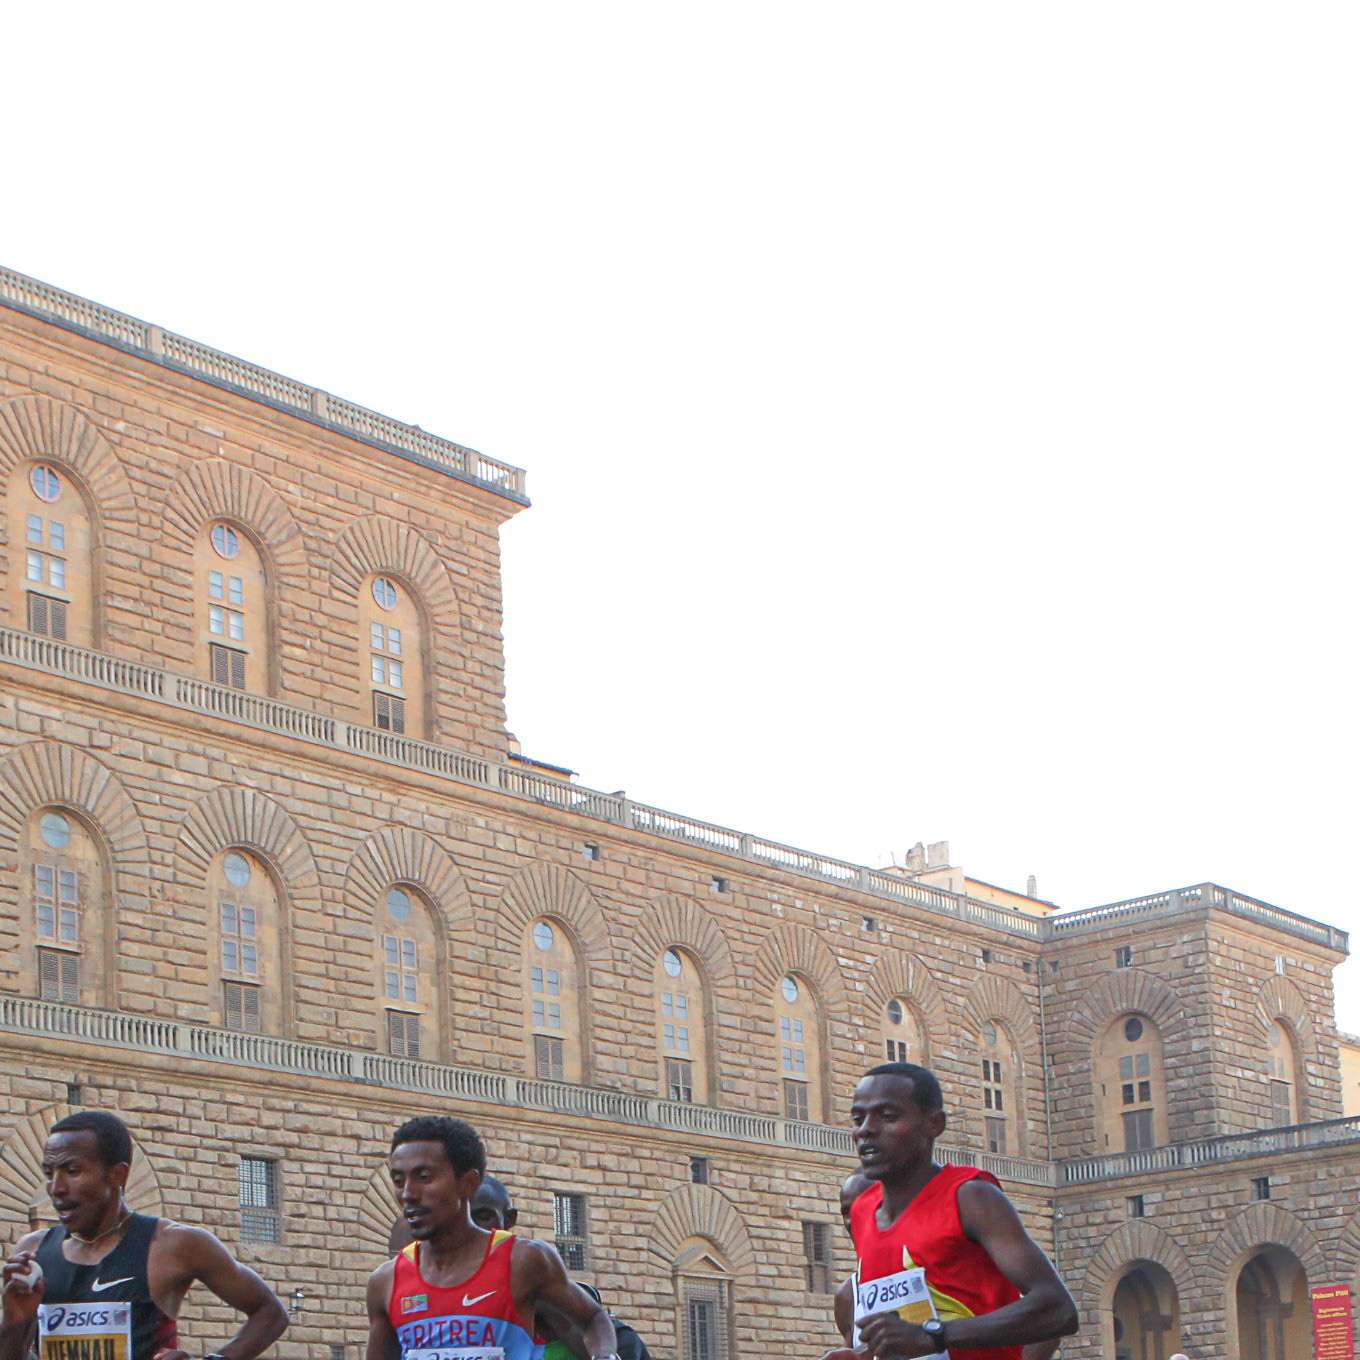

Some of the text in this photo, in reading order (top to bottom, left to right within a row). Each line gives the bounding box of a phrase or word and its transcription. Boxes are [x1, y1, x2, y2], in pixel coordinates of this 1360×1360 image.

[880, 1281, 910, 1302] asics
[66, 1311, 109, 1327] asics
[401, 1319, 497, 1348] ERITREA
